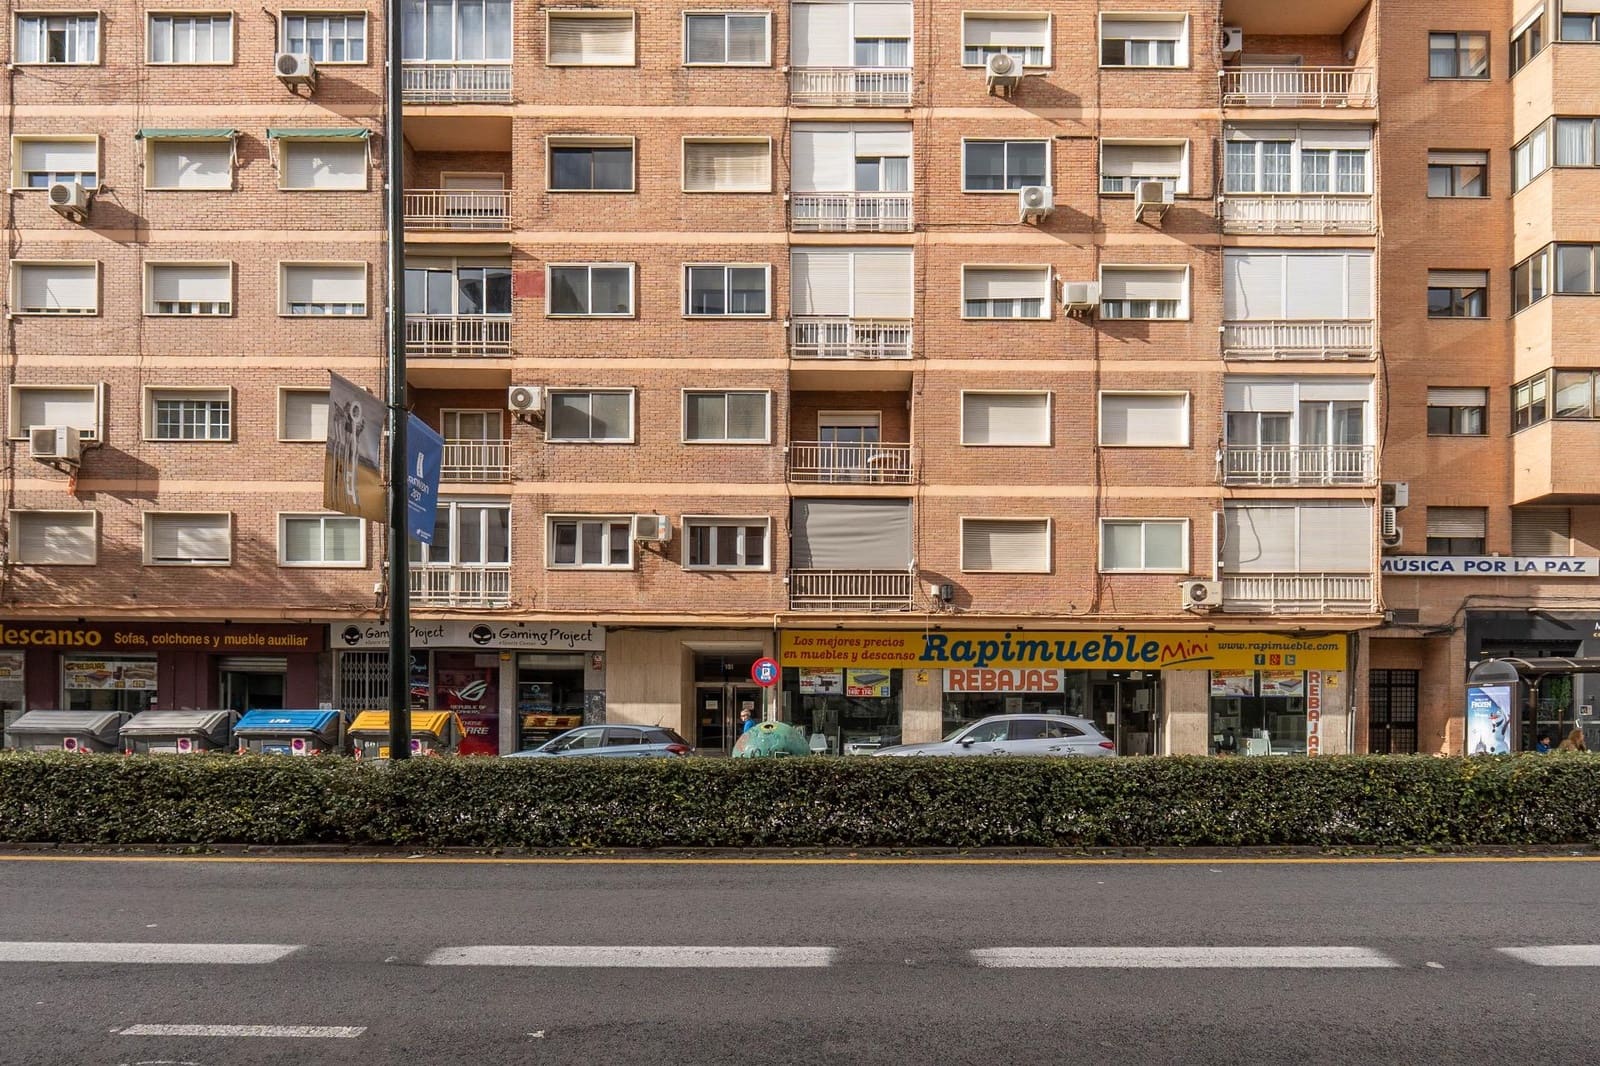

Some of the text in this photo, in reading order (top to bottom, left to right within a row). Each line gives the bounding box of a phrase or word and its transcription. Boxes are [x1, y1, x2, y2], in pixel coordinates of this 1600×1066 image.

[1380, 558, 1586, 573] MÚSICA POR LA PAZ
[0, 624, 102, 646] escanso
[114, 632, 309, 647] Sofas, colchones y mueble auxiliar
[498, 628, 593, 647] Gaming Project
[793, 636, 905, 648] Los mejores precios
[919, 633, 1209, 667] Rapimueble Mini
[1217, 641, 1339, 652] www.rapimueble.com
[784, 650, 916, 662] en muebles y descanso
[949, 669, 1059, 692] REBAJAS
[466, 727, 489, 735] ARE
